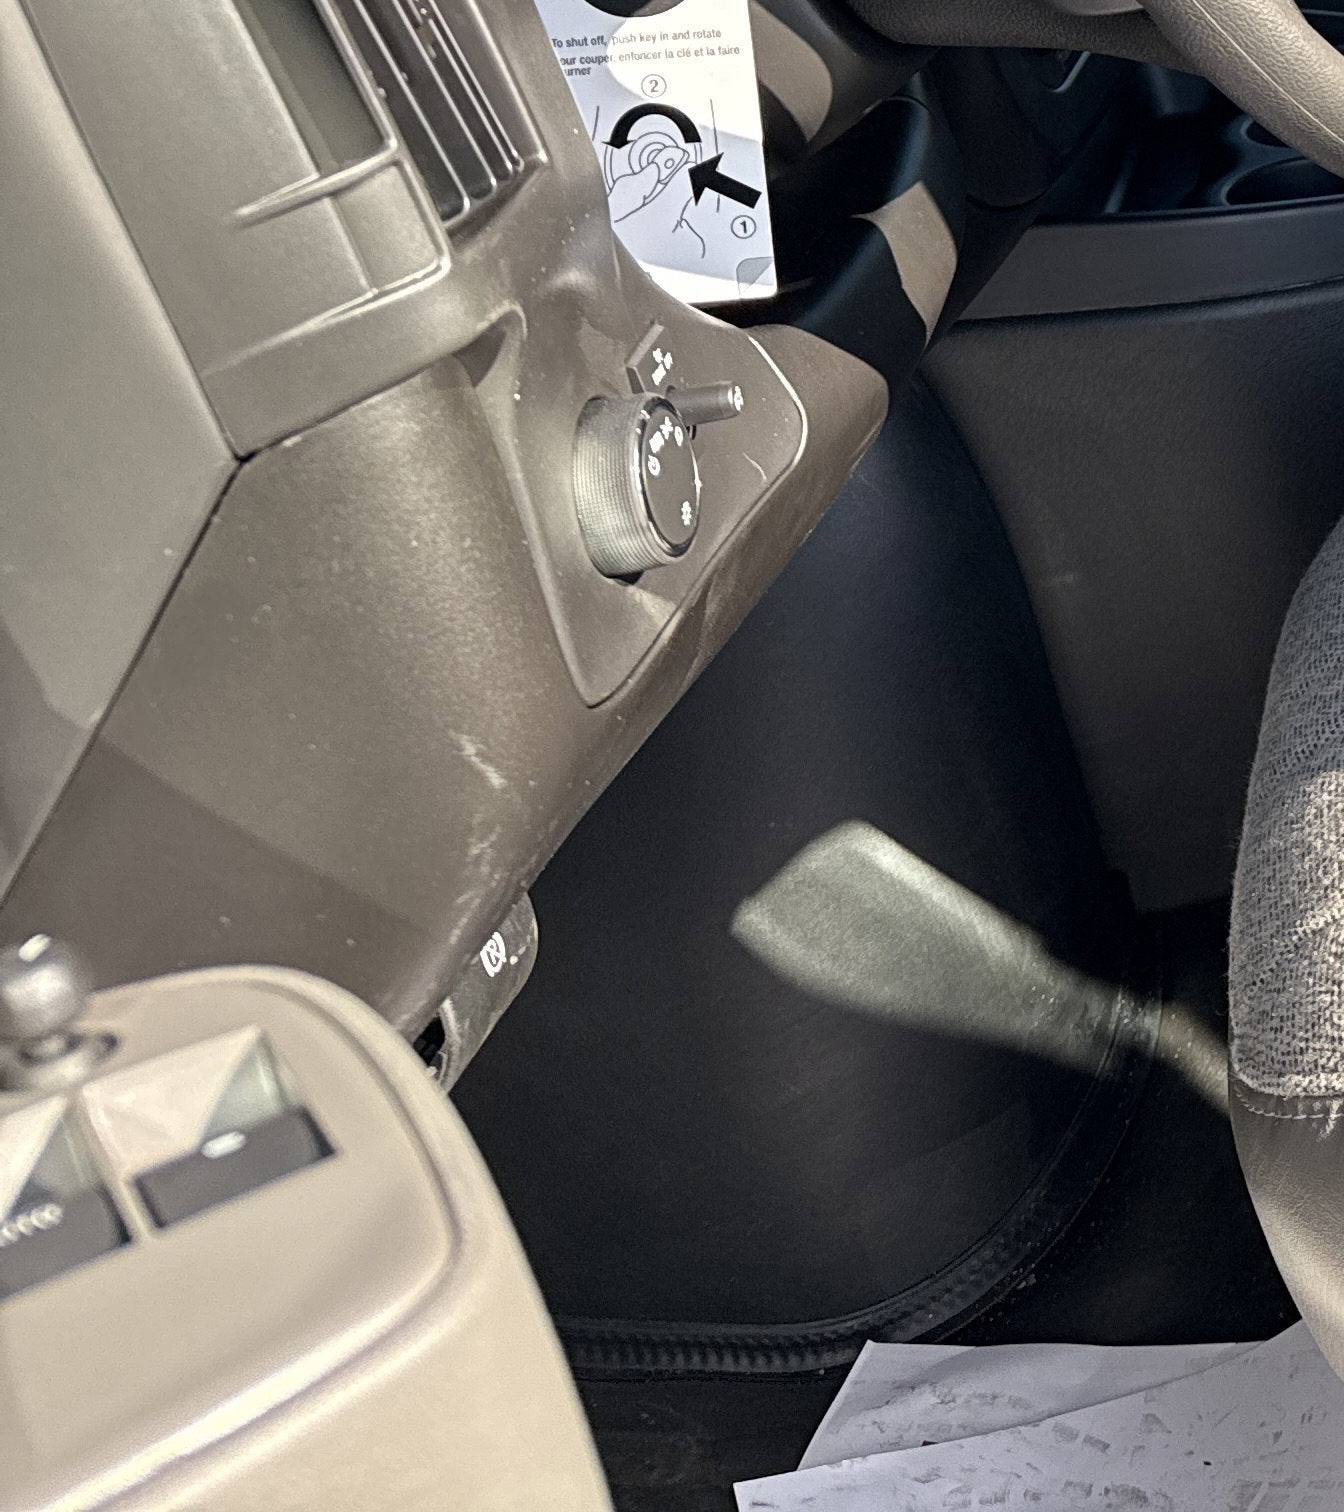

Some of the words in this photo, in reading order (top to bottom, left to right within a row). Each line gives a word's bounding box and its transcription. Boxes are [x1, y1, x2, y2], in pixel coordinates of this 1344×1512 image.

[552, 38, 563, 49] To
[565, 37, 588, 48] shut
[591, 35, 608, 47] off,
[612, 33, 636, 45] push
[639, 32, 656, 44] key
[659, 31, 669, 41] in
[672, 31, 690, 41] and
[692, 29, 722, 40] rotate
[560, 56, 576, 66] our
[579, 54, 616, 67] couper,
[618, 50, 662, 62] enfoncer
[665, 49, 674, 59] la
[676, 47, 691, 58] clé
[694, 46, 704, 57] et
[706, 46, 716, 56] la
[718, 44, 740, 56] faire
